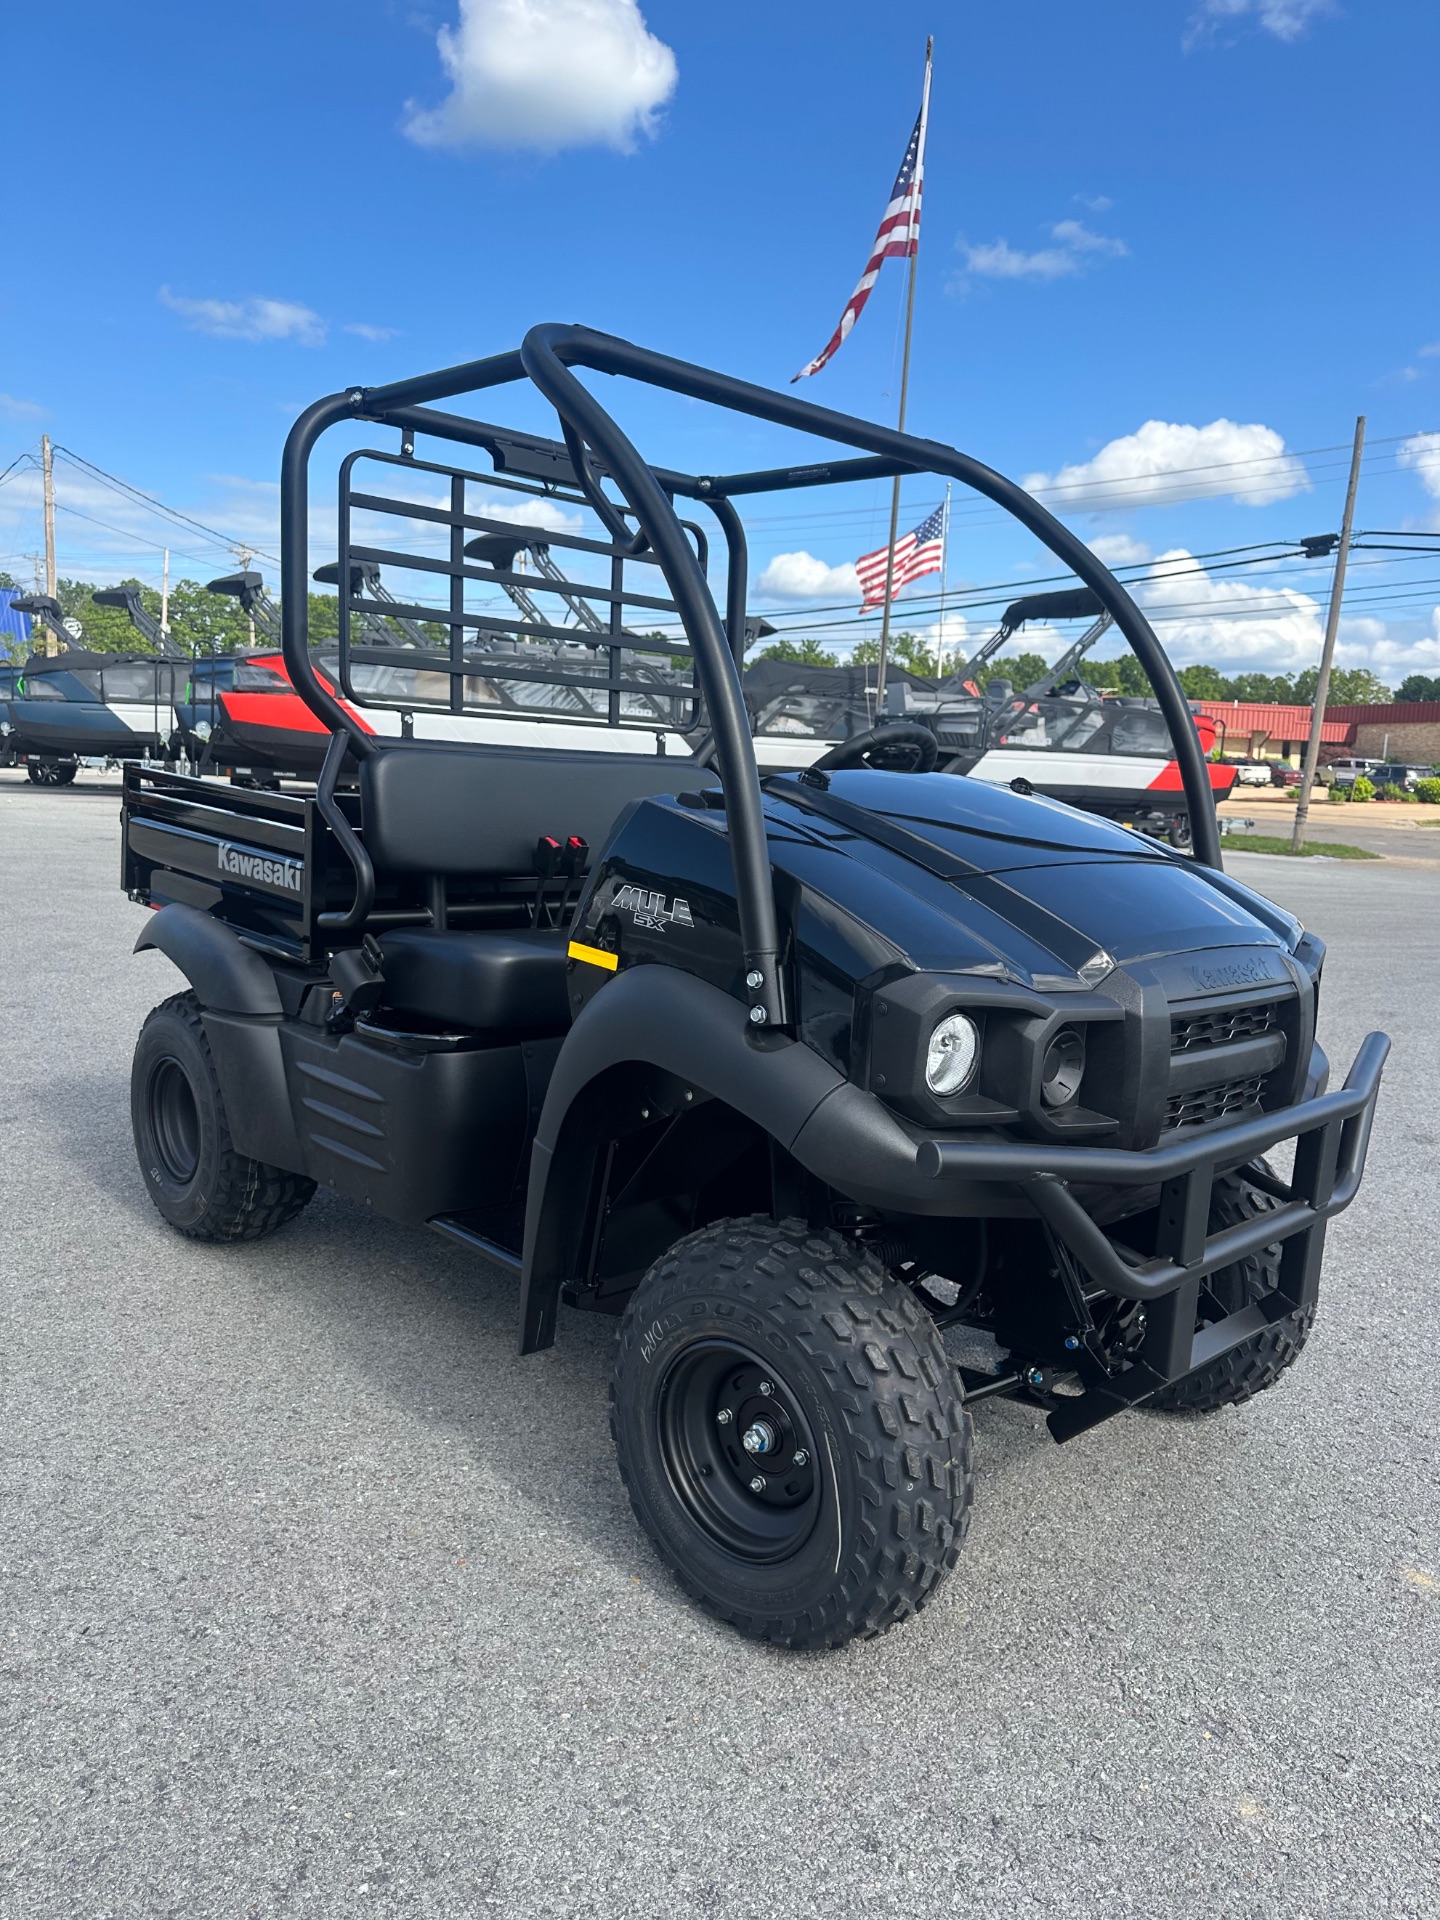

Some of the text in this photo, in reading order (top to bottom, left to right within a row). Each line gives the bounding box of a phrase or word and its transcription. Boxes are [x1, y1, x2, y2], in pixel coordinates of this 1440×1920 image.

[217, 842, 302, 891] Kawasaki
[611, 885, 694, 927] MULE
[633, 912, 666, 932] SX
[689, 1301, 790, 1352] DURO
